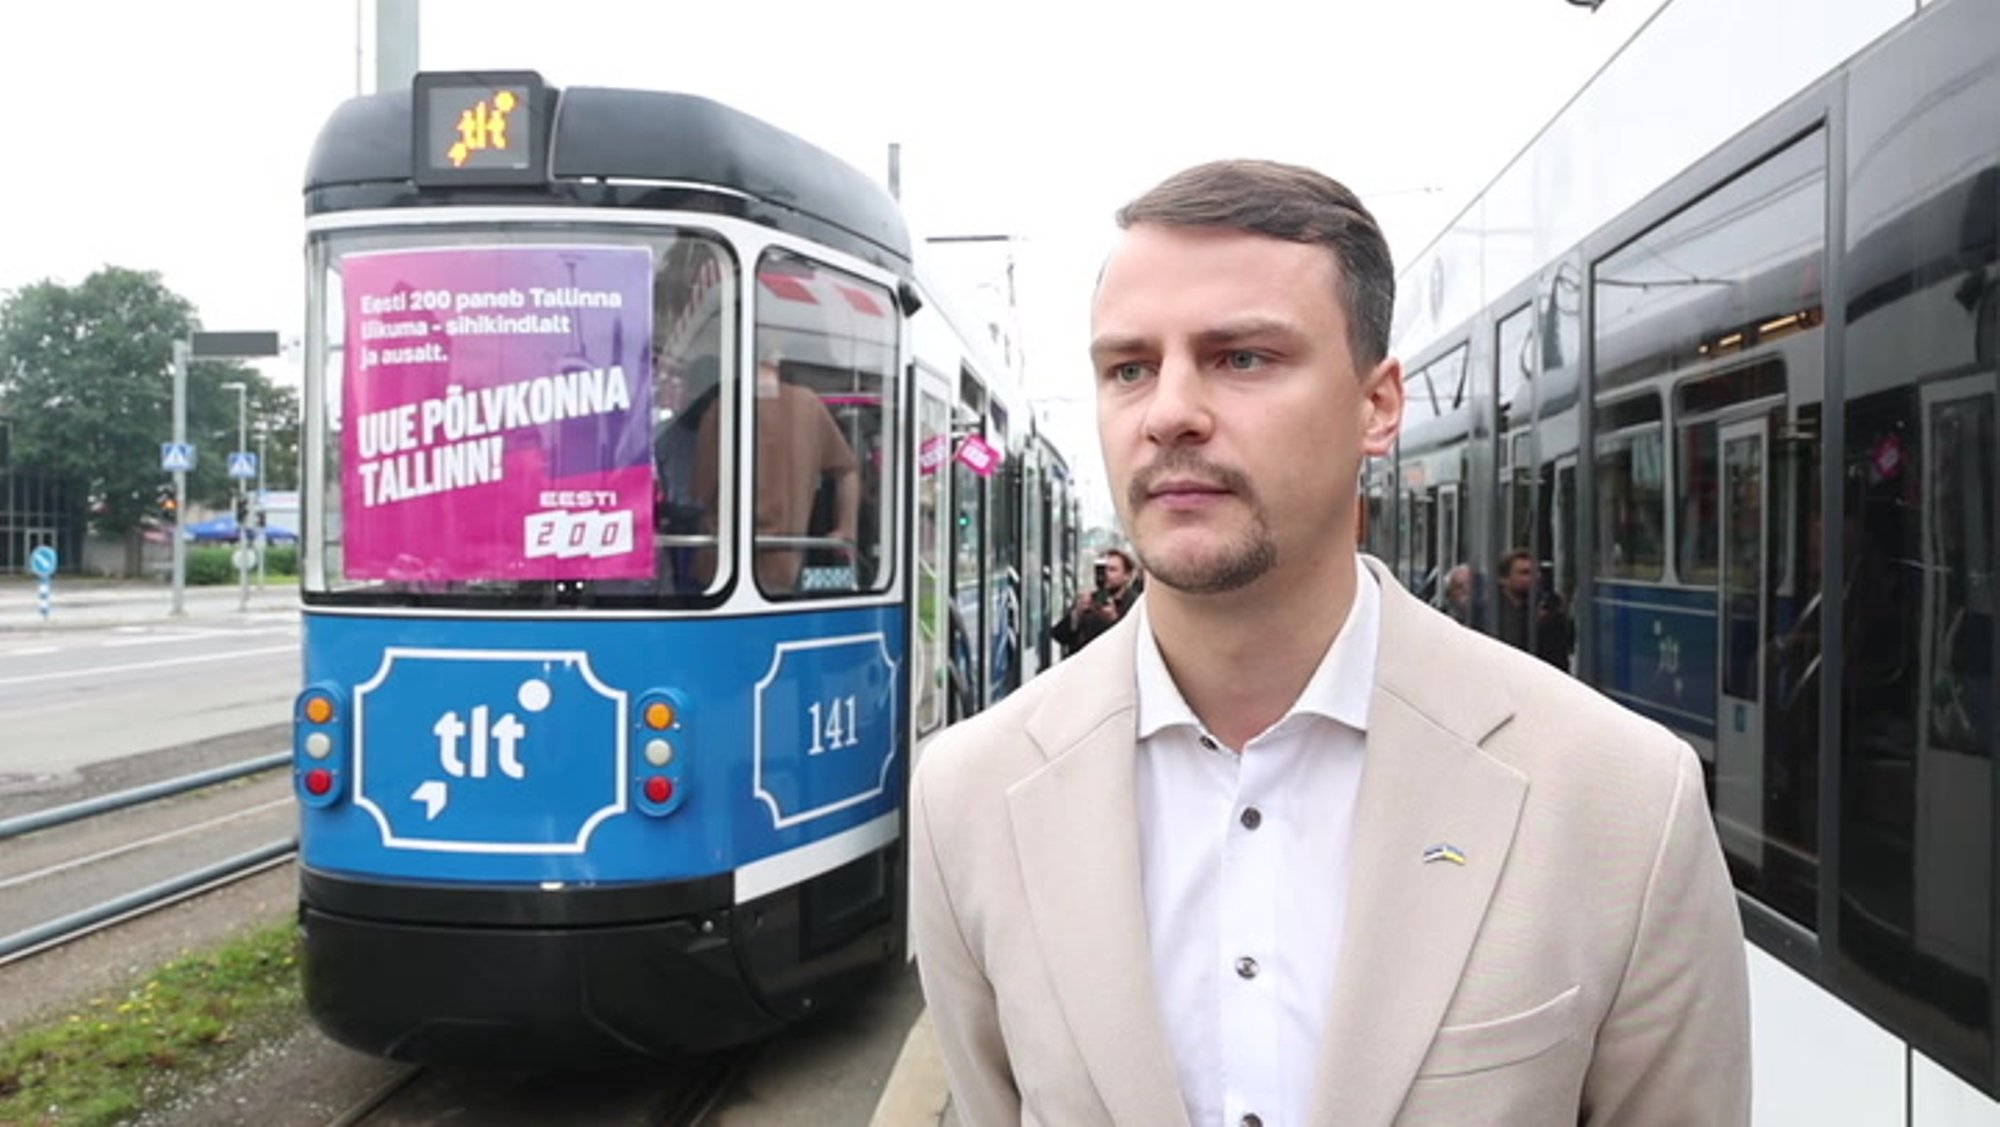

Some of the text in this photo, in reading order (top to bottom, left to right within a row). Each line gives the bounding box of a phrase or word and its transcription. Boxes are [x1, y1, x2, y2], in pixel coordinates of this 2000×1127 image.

[361, 288, 622, 314] Eesti 200 paneb Tallinna
[361, 319, 428, 340] liikuma
[446, 315, 571, 335] sihikindlalt
[360, 343, 448, 371] ja ausalt.
[357, 366, 630, 459] UUE PÕLVKONNA
[358, 434, 503, 508] TALLINN!
[540, 490, 617, 507] EESTI
[537, 521, 619, 546] 200
[807, 696, 858, 756] 141
[434, 704, 525, 780] tlt
